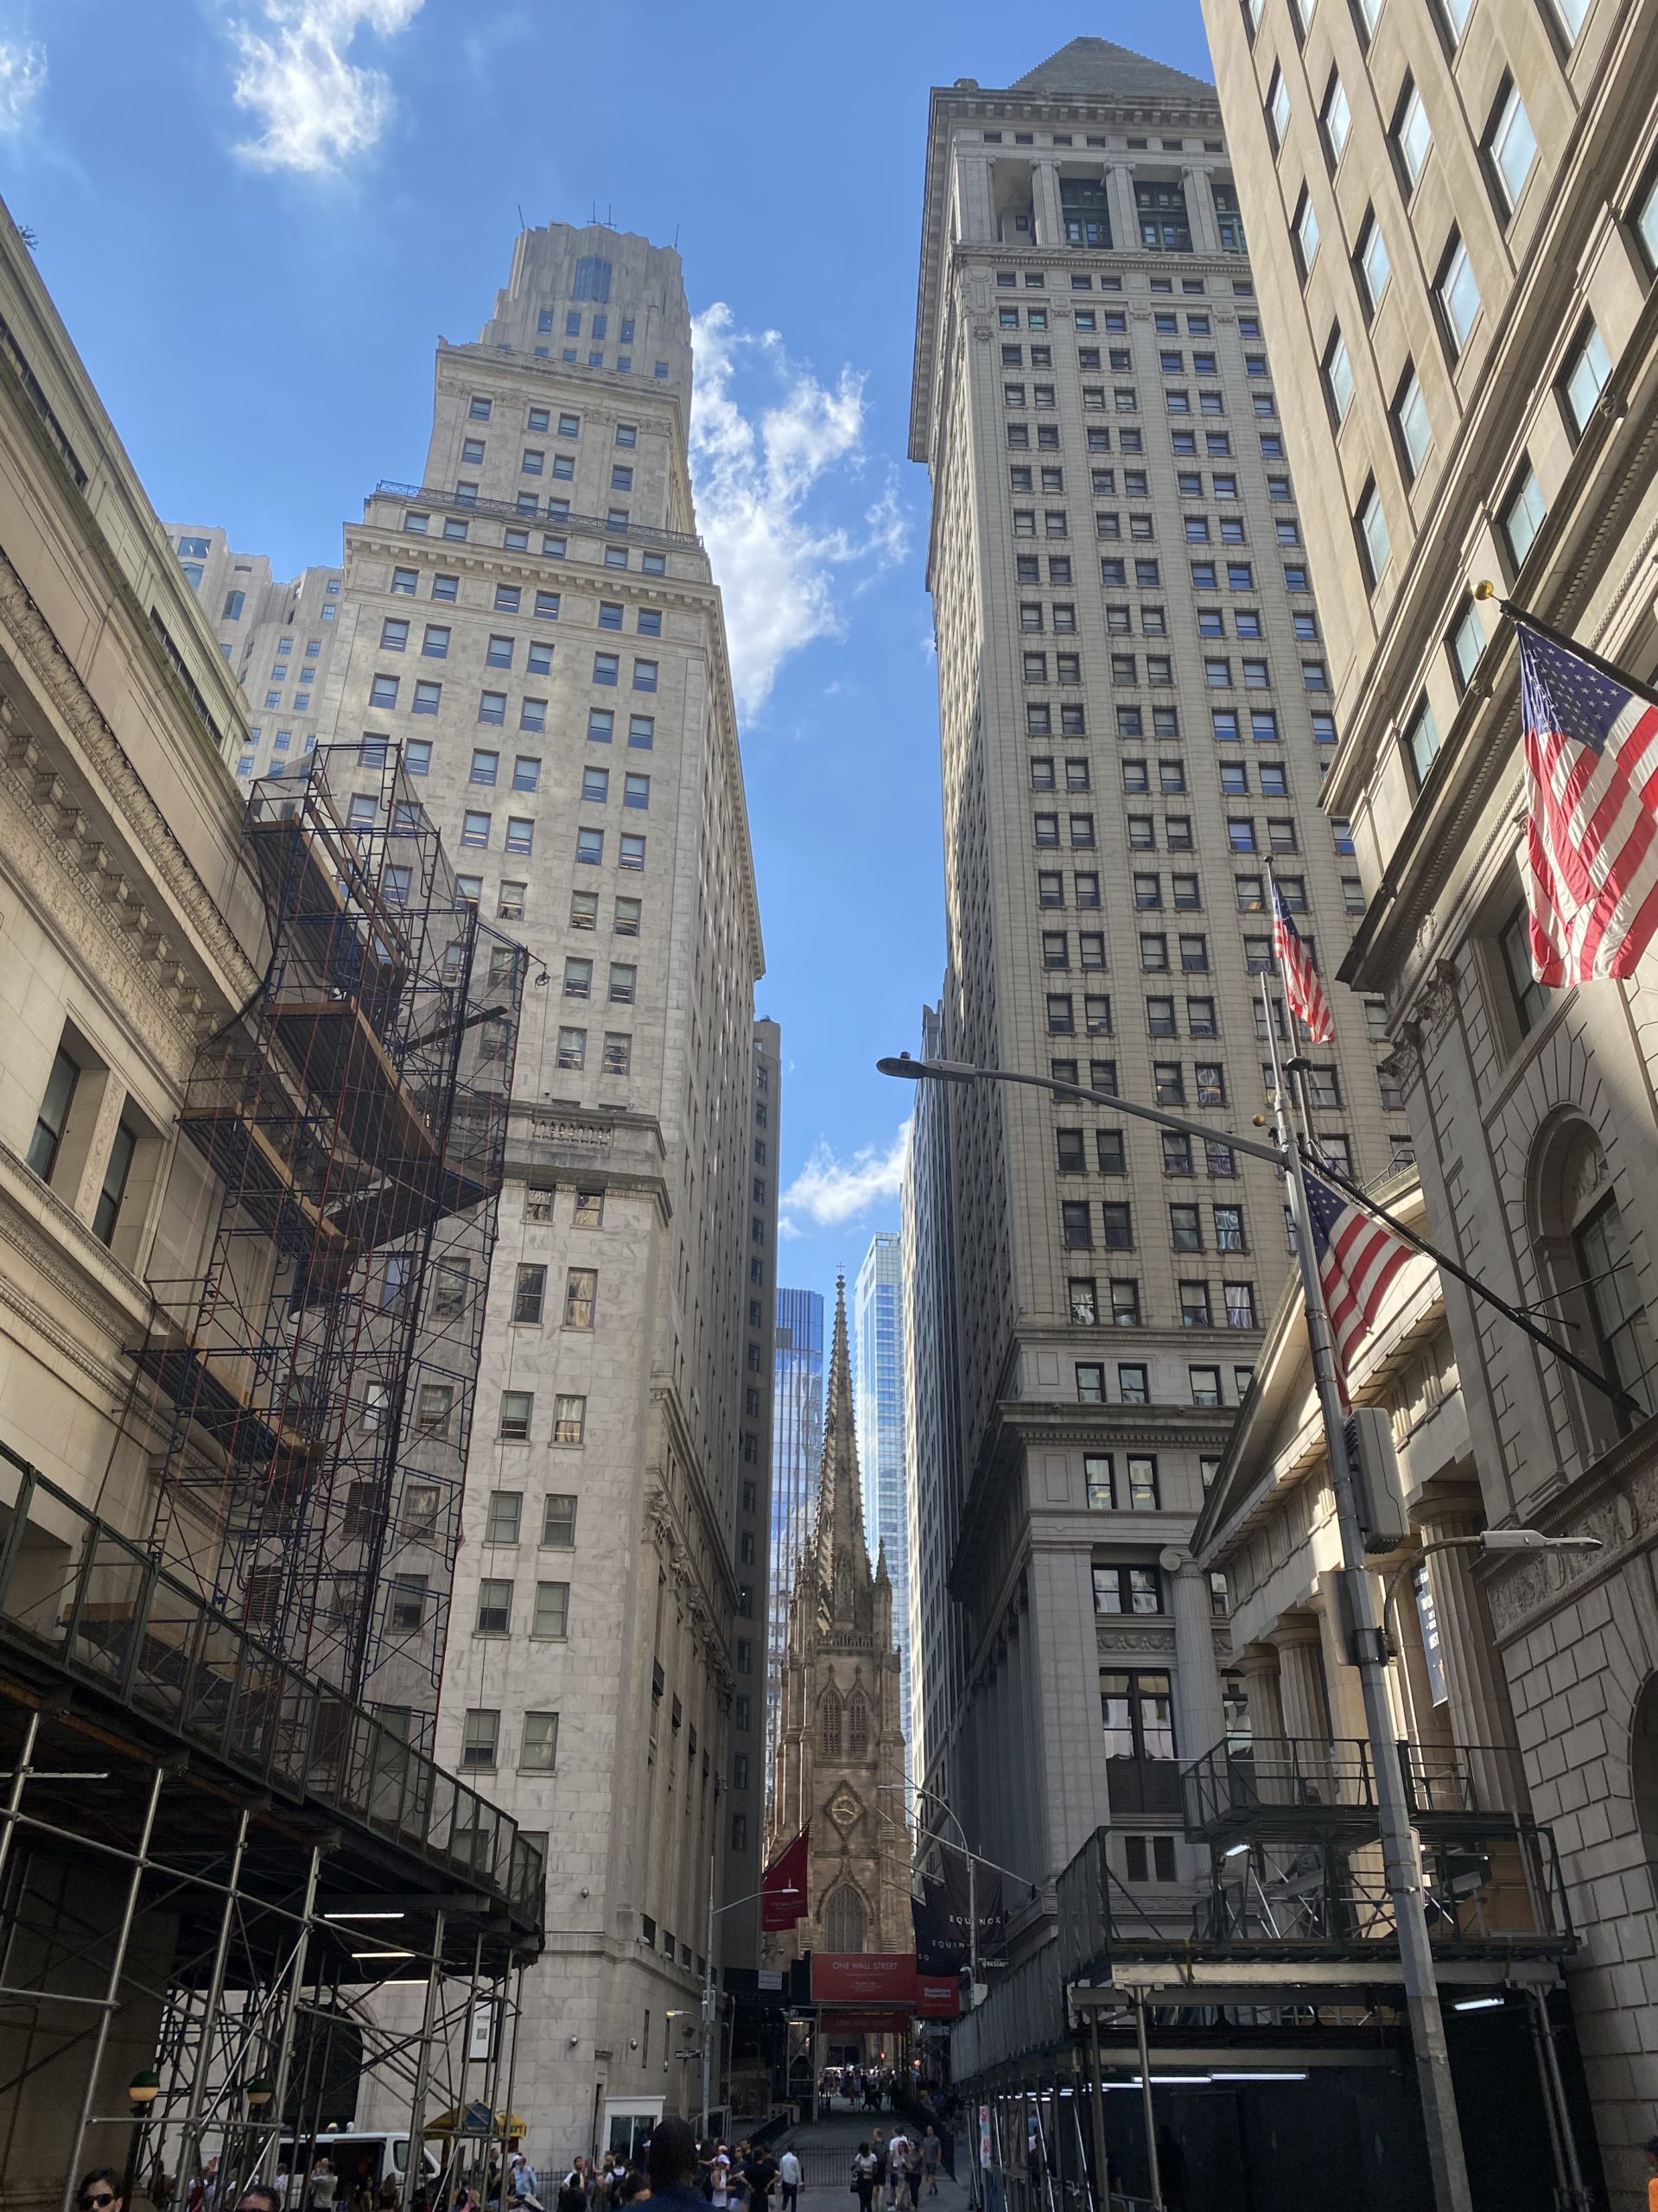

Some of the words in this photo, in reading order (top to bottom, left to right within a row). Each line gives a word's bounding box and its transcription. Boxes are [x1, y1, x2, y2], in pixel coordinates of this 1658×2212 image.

[950, 1915, 1001, 1926] EQUNOX
[832, 1961, 850, 1970] ONE
[852, 1961, 871, 1970] WALL
[873, 1961, 899, 1971] STREET
